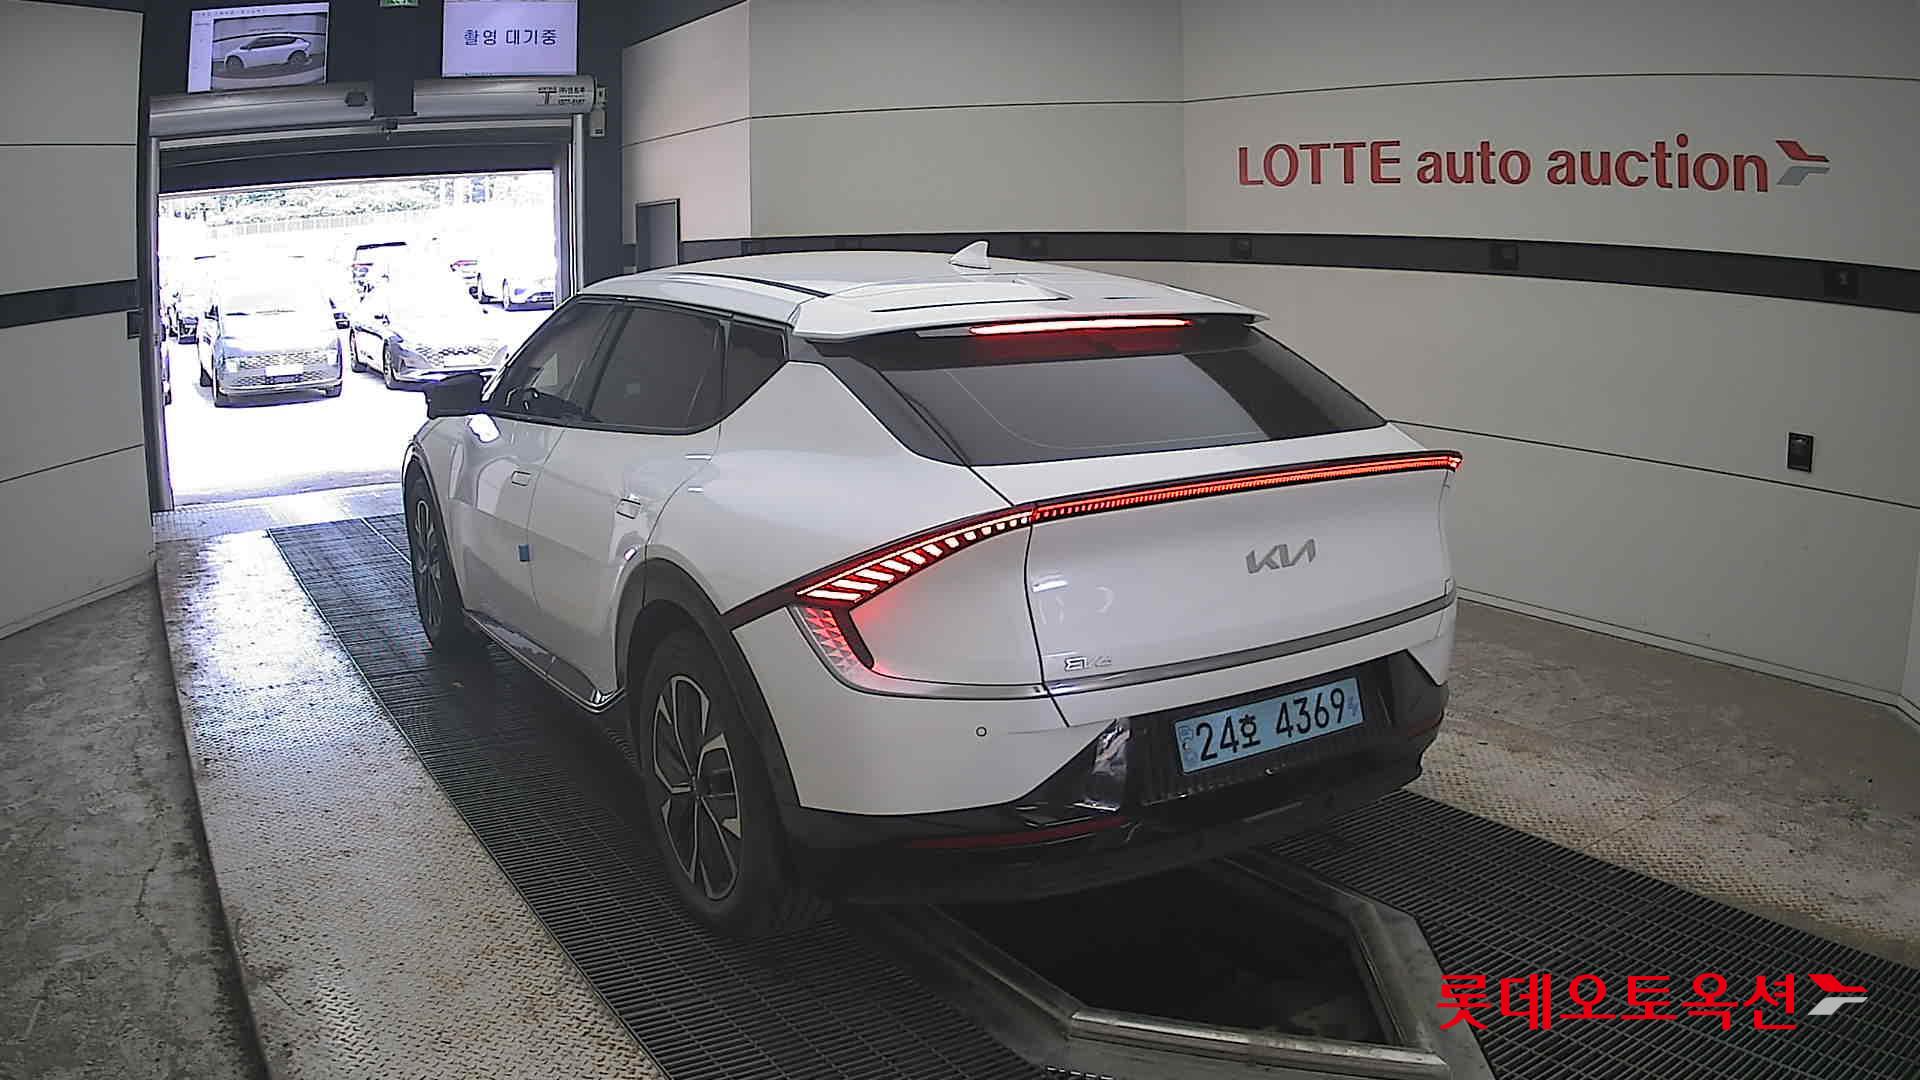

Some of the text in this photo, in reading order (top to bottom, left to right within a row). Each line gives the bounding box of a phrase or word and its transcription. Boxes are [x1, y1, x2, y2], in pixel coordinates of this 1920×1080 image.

[464, 29, 558, 46] 촬영 대기중
[1238, 133, 1768, 192] LOTTE auto auction
[1196, 688, 1345, 761] 24호 4369
